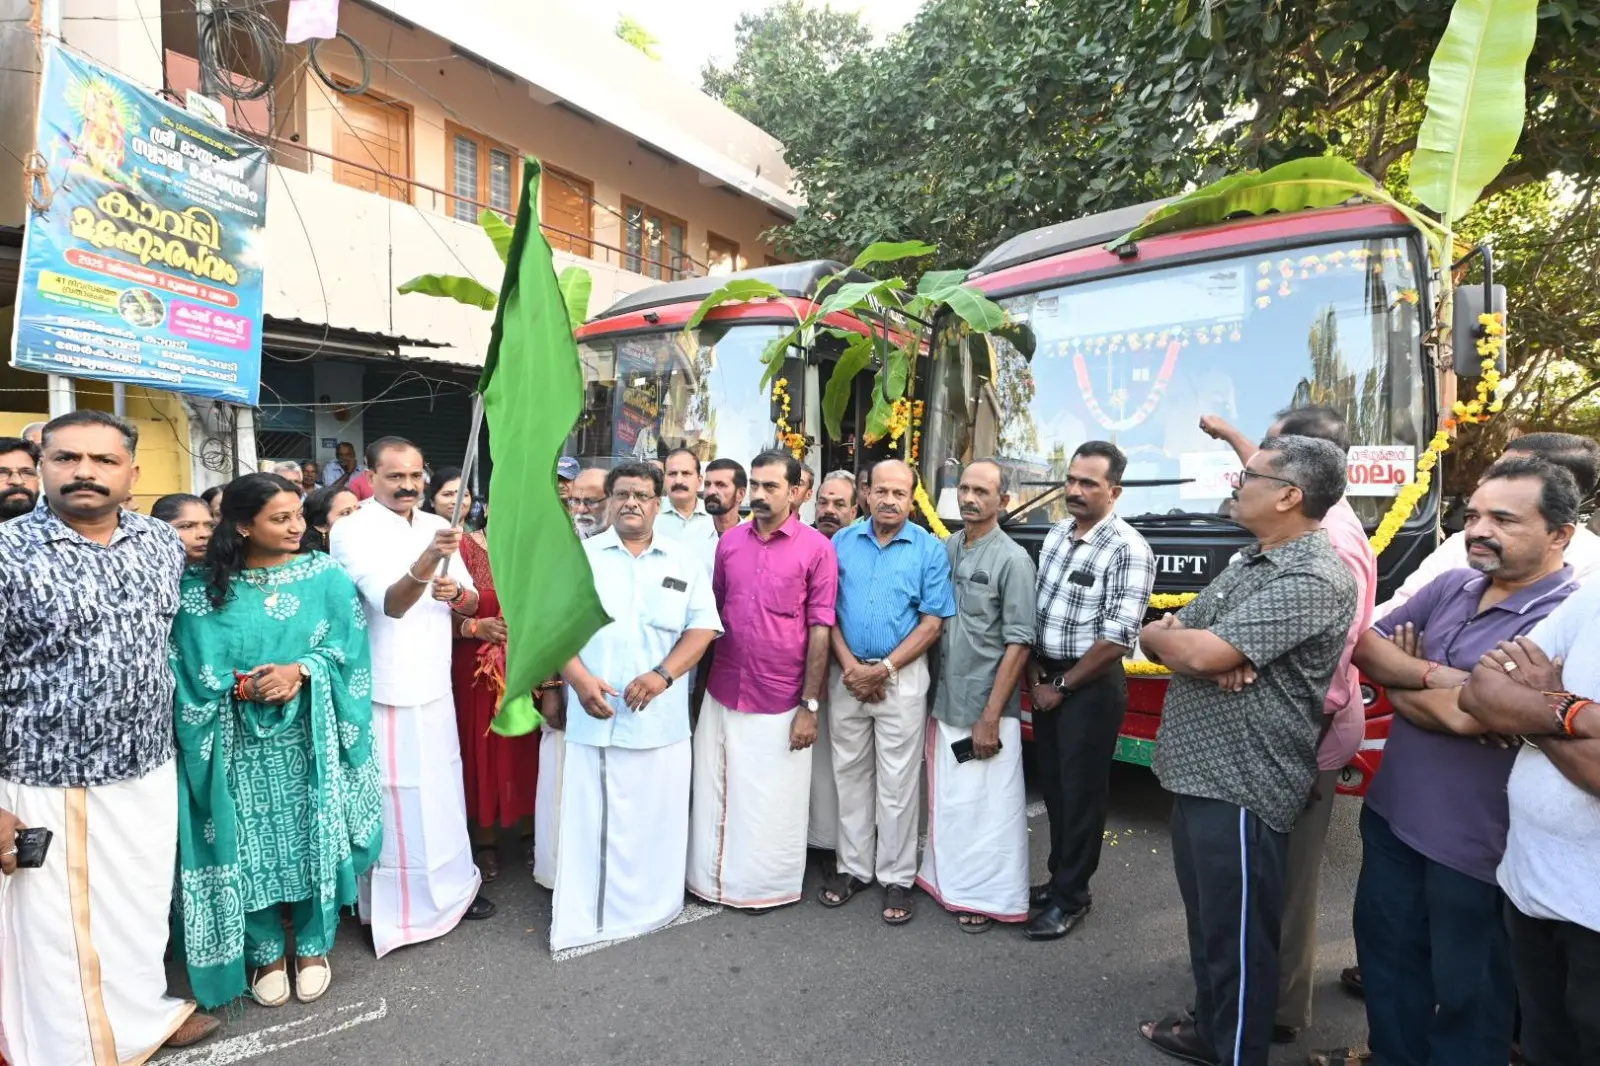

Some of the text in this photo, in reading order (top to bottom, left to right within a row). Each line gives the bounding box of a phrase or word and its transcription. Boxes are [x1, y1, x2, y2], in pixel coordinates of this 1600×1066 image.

[96, 190, 222, 251] കാവടി
[77, 253, 103, 268] 2025
[55, 275, 65, 284] 41
[1155, 554, 1207, 574] IFT
